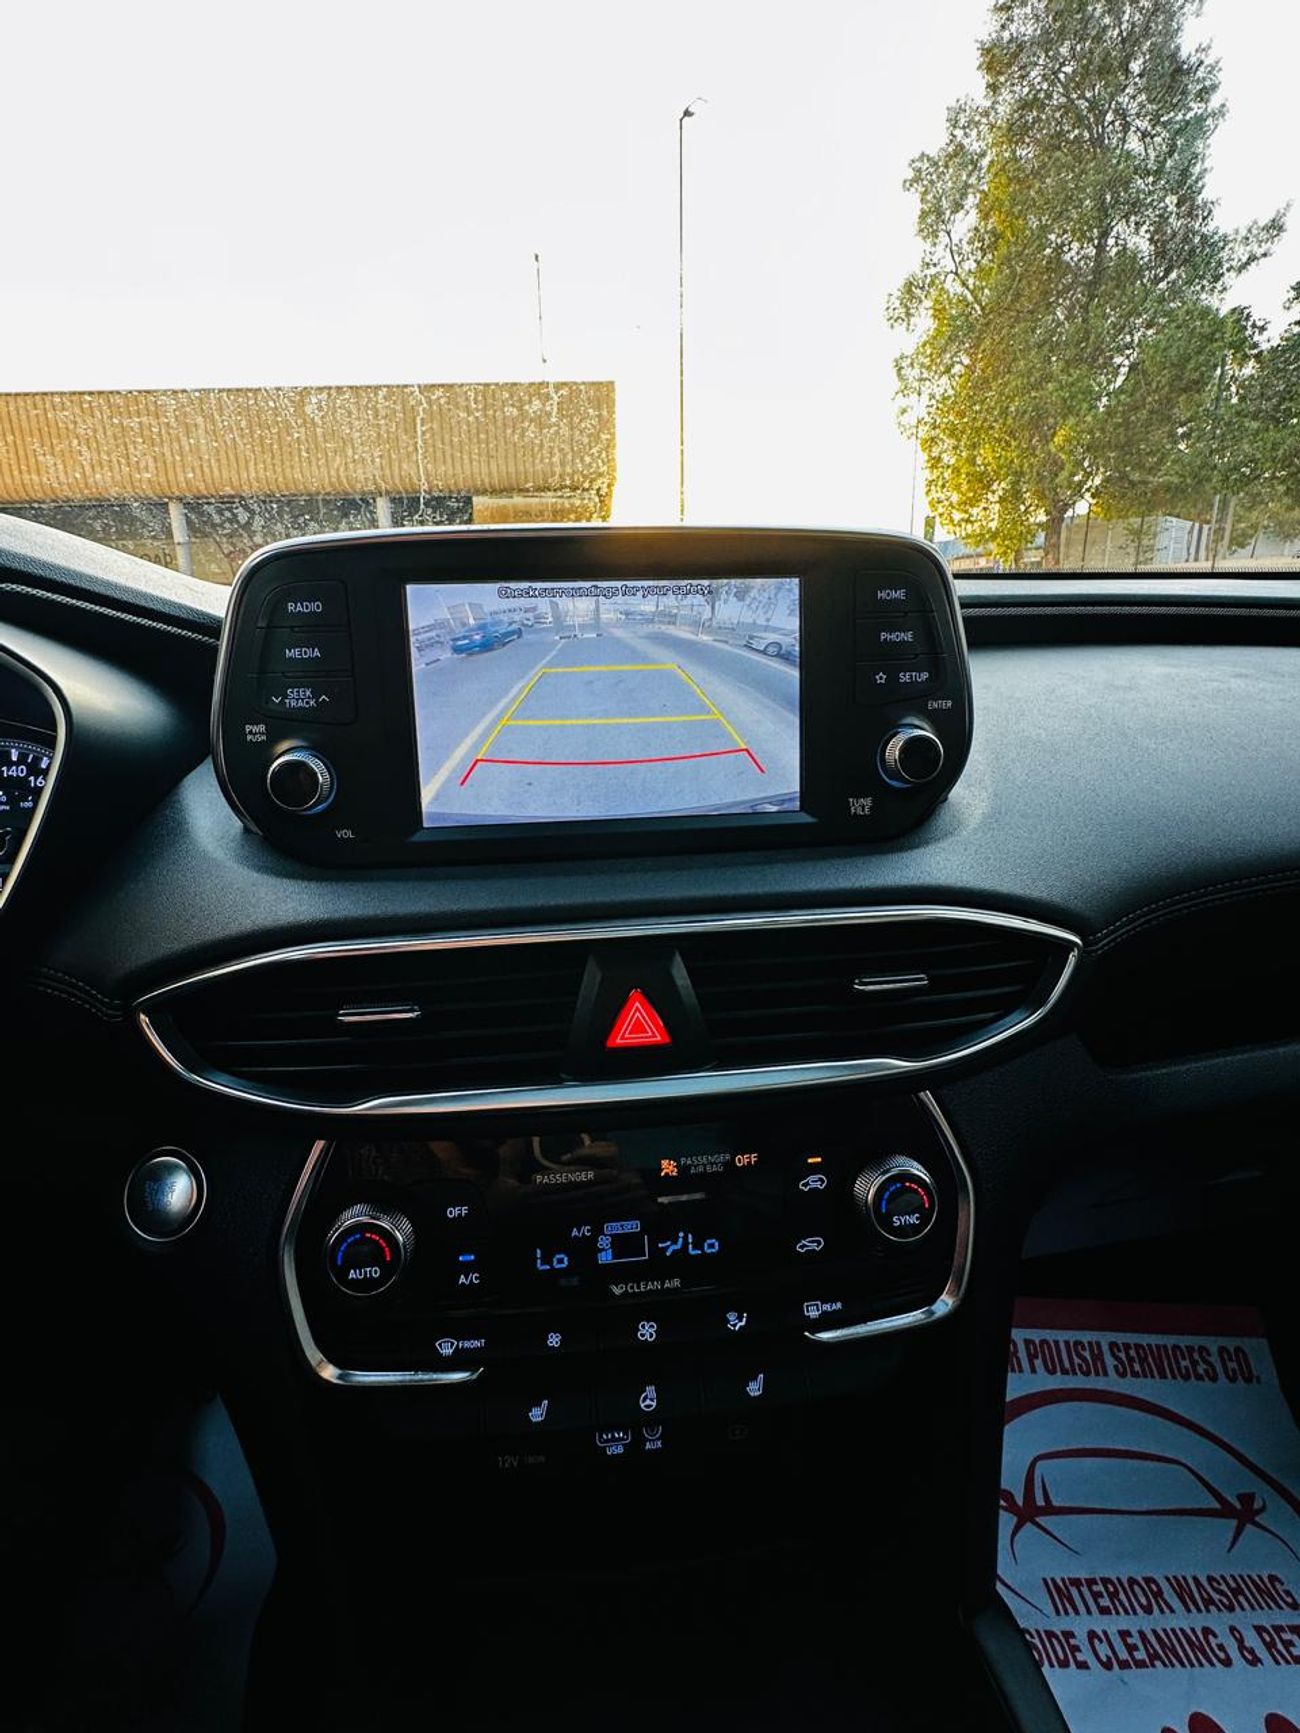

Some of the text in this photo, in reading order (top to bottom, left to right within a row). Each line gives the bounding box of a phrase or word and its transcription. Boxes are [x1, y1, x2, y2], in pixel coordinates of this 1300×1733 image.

[498, 586, 539, 599] Check
[539, 585, 619, 599] surroundings
[621, 584, 641, 597] for
[642, 584, 670, 597] your
[877, 589, 906, 600] HOME
[287, 602, 322, 613] RADIO
[880, 631, 914, 642] PHONE
[285, 648, 321, 659] MEDIA
[899, 672, 929, 683] SETUP
[287, 688, 313, 699] SEEK
[284, 699, 317, 708] TRACK
[927, 700, 952, 710] ENTER
[245, 724, 266, 734] PWR
[247, 734, 267, 742] PUSH
[1, 765, 27, 777] 140
[28, 775, 46, 787] 16
[849, 798, 873, 807] TUNE
[850, 806, 872, 816] FILE
[336, 830, 355, 839] VOL
[680, 1153, 731, 1167] PASSENGER
[735, 1153, 759, 1167] OFF
[690, 1164, 724, 1175] AIR BAG
[536, 1171, 595, 1185] PASSENGER
[446, 1207, 469, 1219] OFF
[892, 1213, 921, 1226] SYNC
[571, 1225, 592, 1238] A/C
[348, 1267, 380, 1280] AUTO
[458, 1272, 481, 1285] A/C
[627, 1278, 681, 1293] CLEAN AIR
[822, 1301, 842, 1312] REAR
[459, 1339, 485, 1350] FRONT
[1024, 1338, 1109, 1377] POLISH
[1110, 1341, 1218, 1381] SERVICES
[1219, 1346, 1261, 1385] CO.
[606, 1445, 624, 1455] USB
[645, 1440, 662, 1450] AUX
[498, 1454, 519, 1468] 12V
[1042, 1574, 1300, 1616] INTERIOR WASHING
[1086, 1626, 1233, 1671] CLEANING
[1229, 1625, 1264, 1668] &
